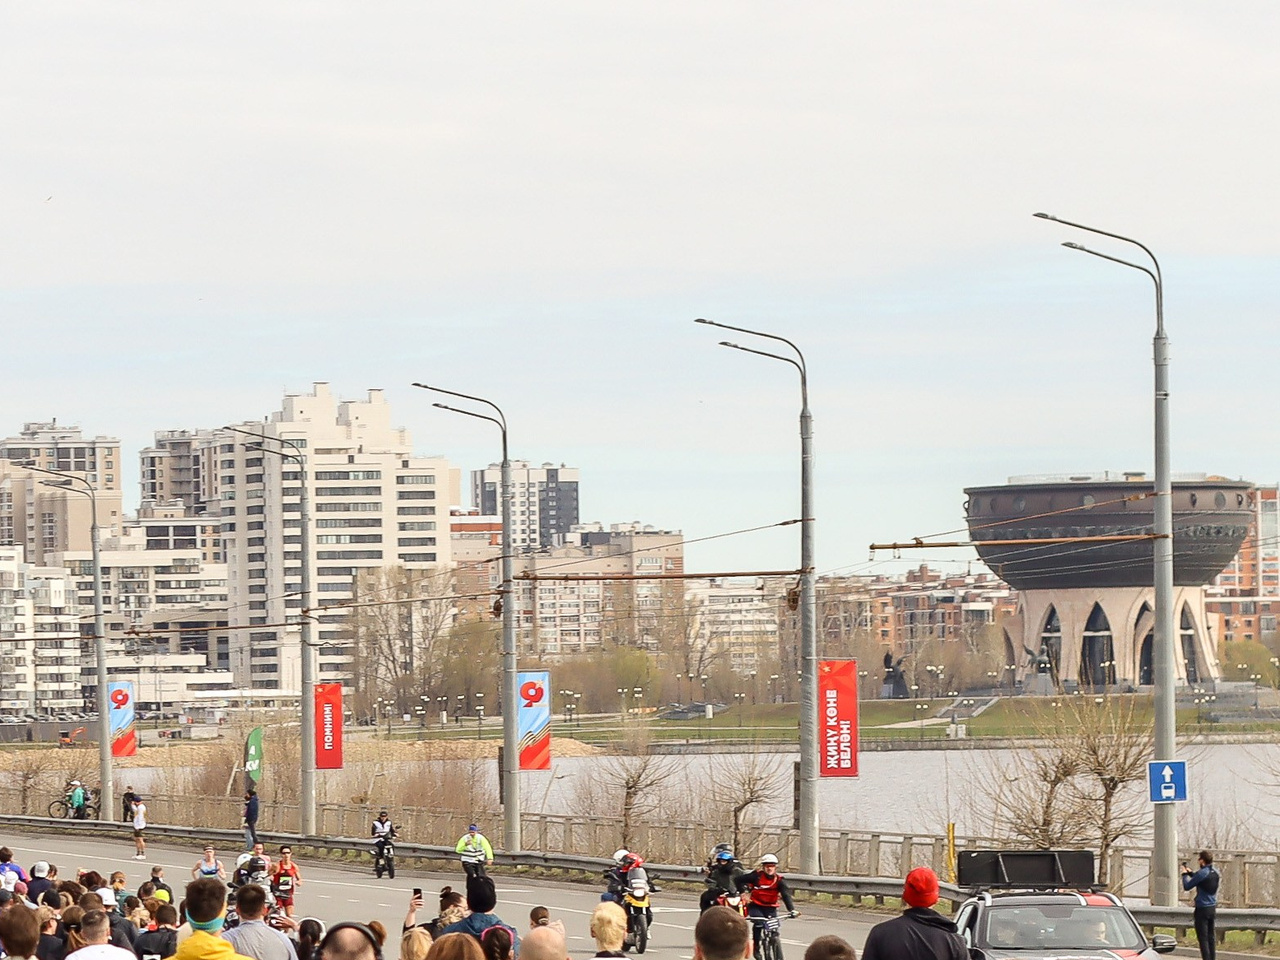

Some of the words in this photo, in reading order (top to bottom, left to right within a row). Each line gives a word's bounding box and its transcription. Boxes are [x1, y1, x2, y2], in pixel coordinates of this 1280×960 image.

[110, 688, 129, 710] 9
[520, 681, 544, 708] 9
[324, 704, 333, 750] ПОМНИМ!
